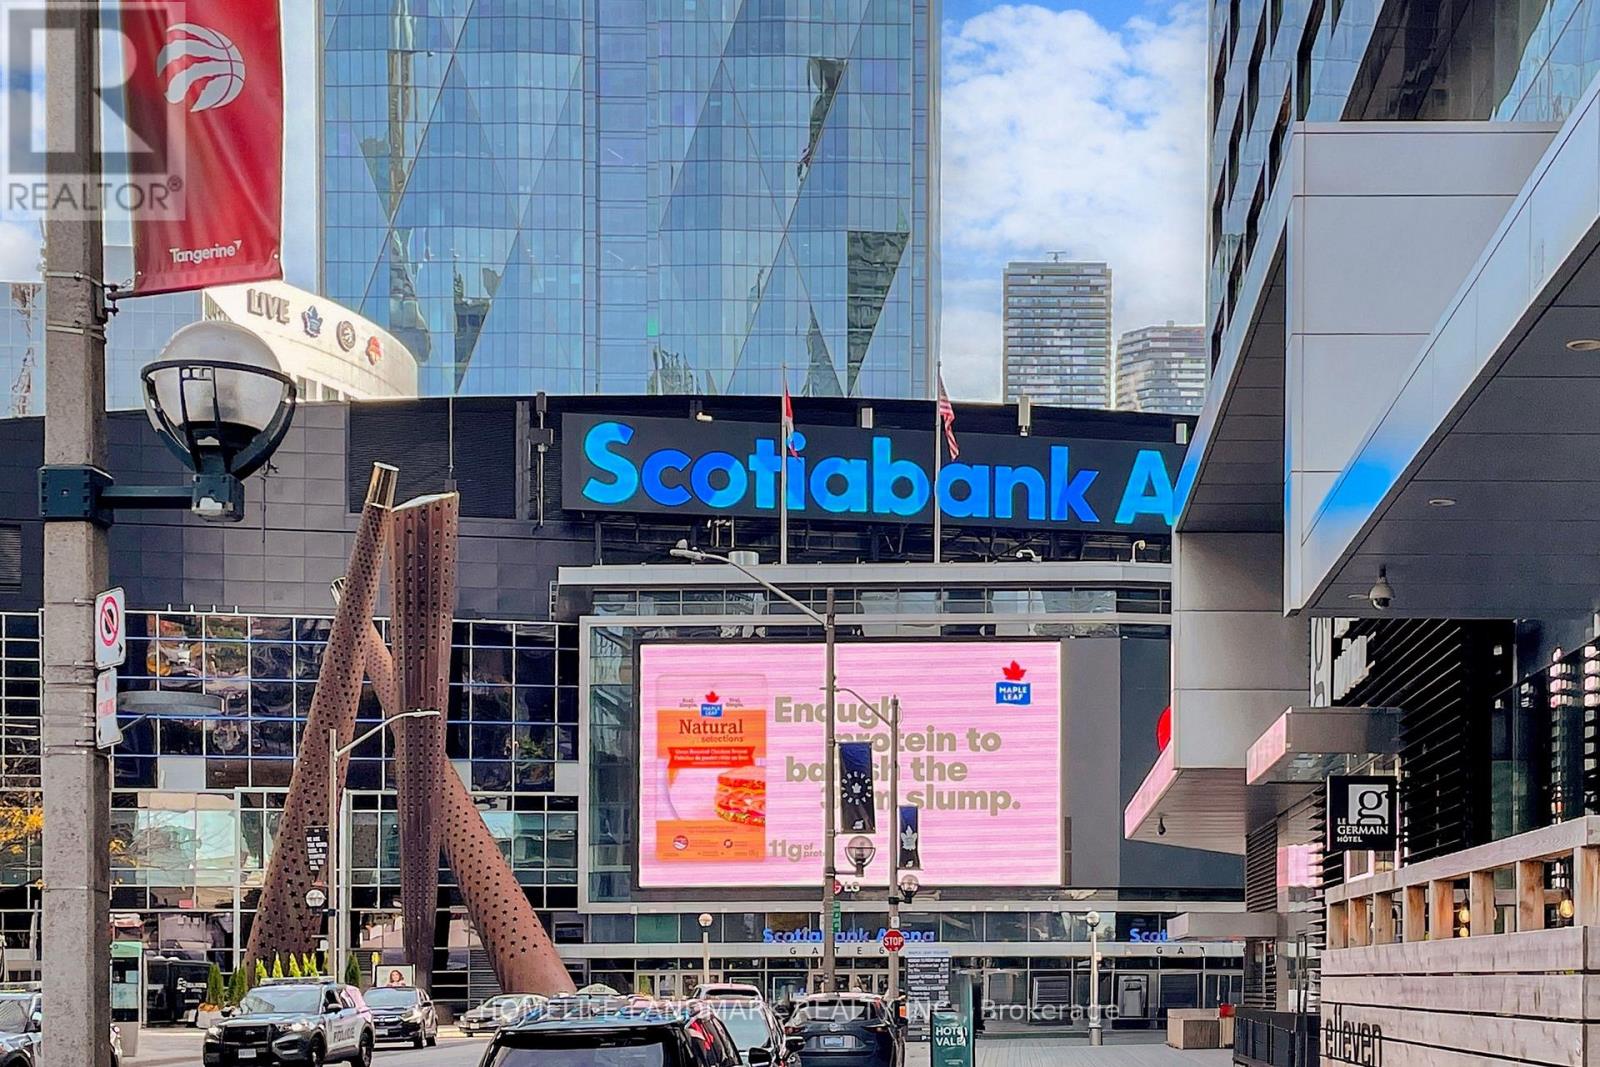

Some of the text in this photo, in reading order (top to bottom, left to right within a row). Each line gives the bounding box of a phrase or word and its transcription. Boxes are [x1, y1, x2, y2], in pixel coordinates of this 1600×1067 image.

[169, 243, 236, 264] Tangerine
[247, 288, 290, 325] LIVE
[582, 421, 1100, 523] Scotiabank
[999, 686, 1027, 694] MAPLE
[1003, 693, 1023, 701] LEAF
[679, 719, 743, 735] Natural
[701, 735, 743, 743] selections
[966, 727, 1002, 752] to
[910, 756, 968, 782] the
[906, 784, 1021, 816] slump.
[1337, 817, 1347, 825] LE
[1336, 825, 1389, 835] GERMAIN
[1336, 834, 1363, 843] HÔTEL
[769, 840, 801, 862] 11g
[844, 882, 861, 892] LG
[763, 927, 935, 943] Scotiaank Aena
[884, 936, 903, 946] STOP
[1325, 1003, 1383, 1067] elleven
